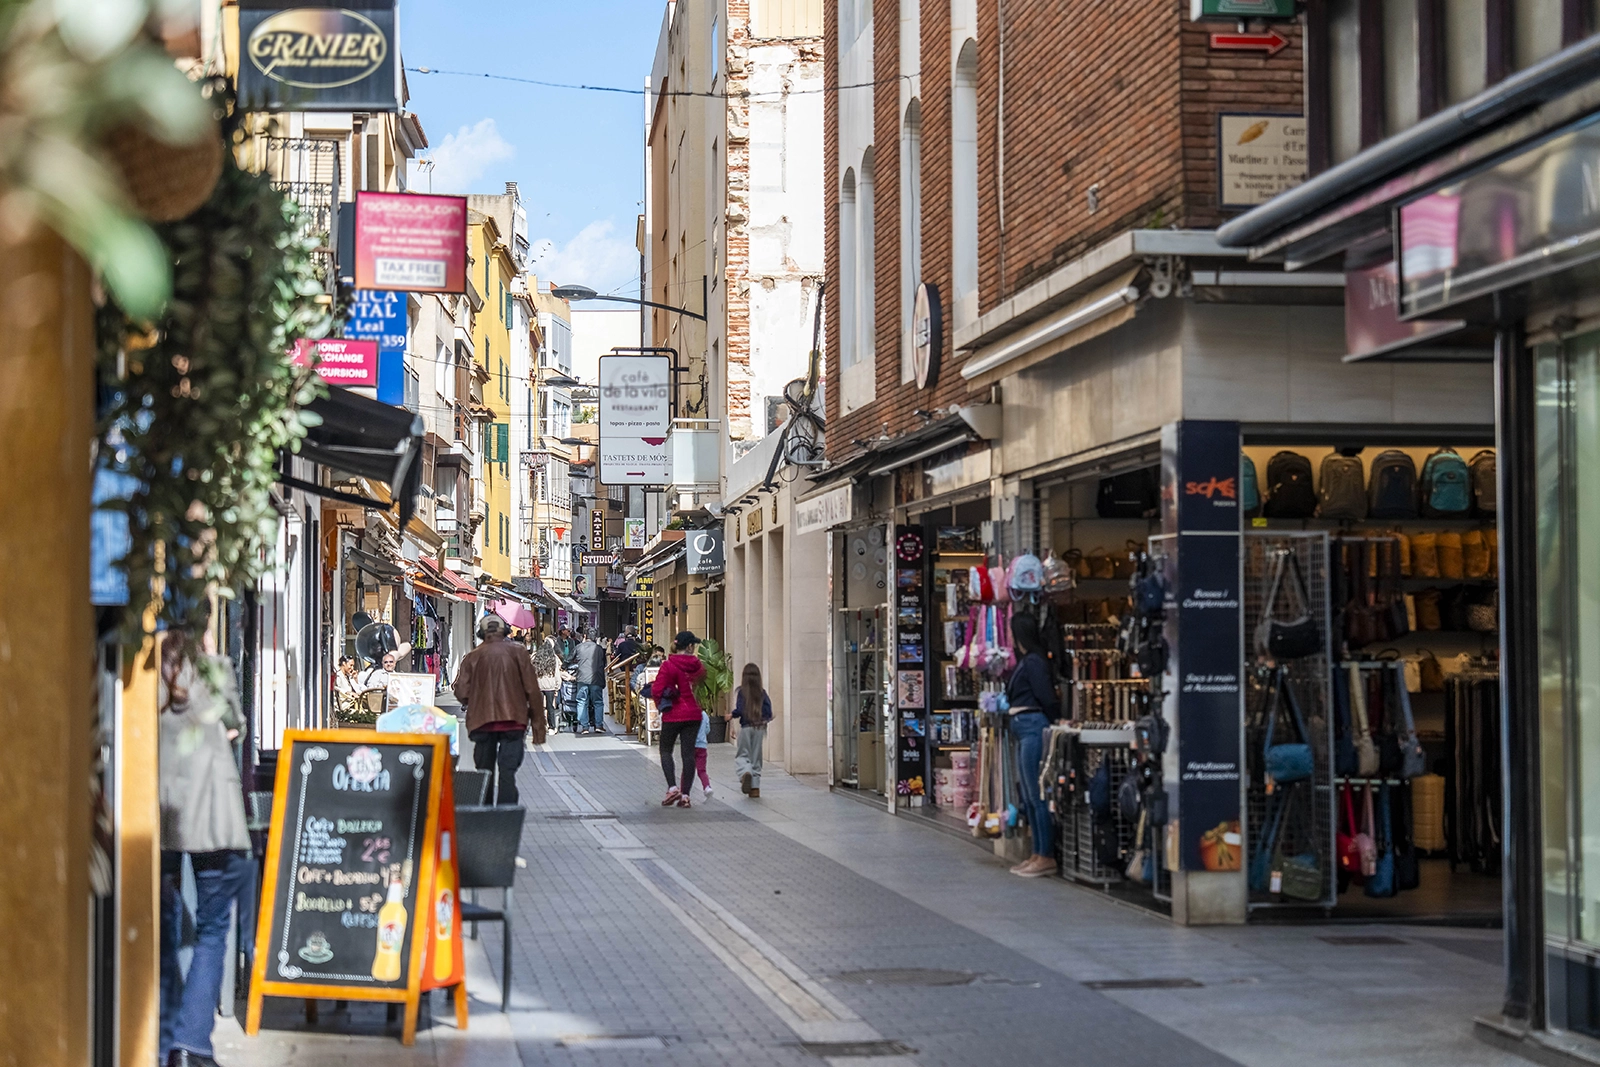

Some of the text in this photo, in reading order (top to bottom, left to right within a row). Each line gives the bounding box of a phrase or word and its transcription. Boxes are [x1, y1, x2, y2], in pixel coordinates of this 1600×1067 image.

[252, 33, 381, 62] GRANIER
[382, 261, 442, 275] TAX FREE
[314, 367, 368, 378] XCURSIONS
[603, 383, 667, 398] de la vila
[593, 511, 602, 548] TATTOO
[582, 555, 613, 564] STUDIO
